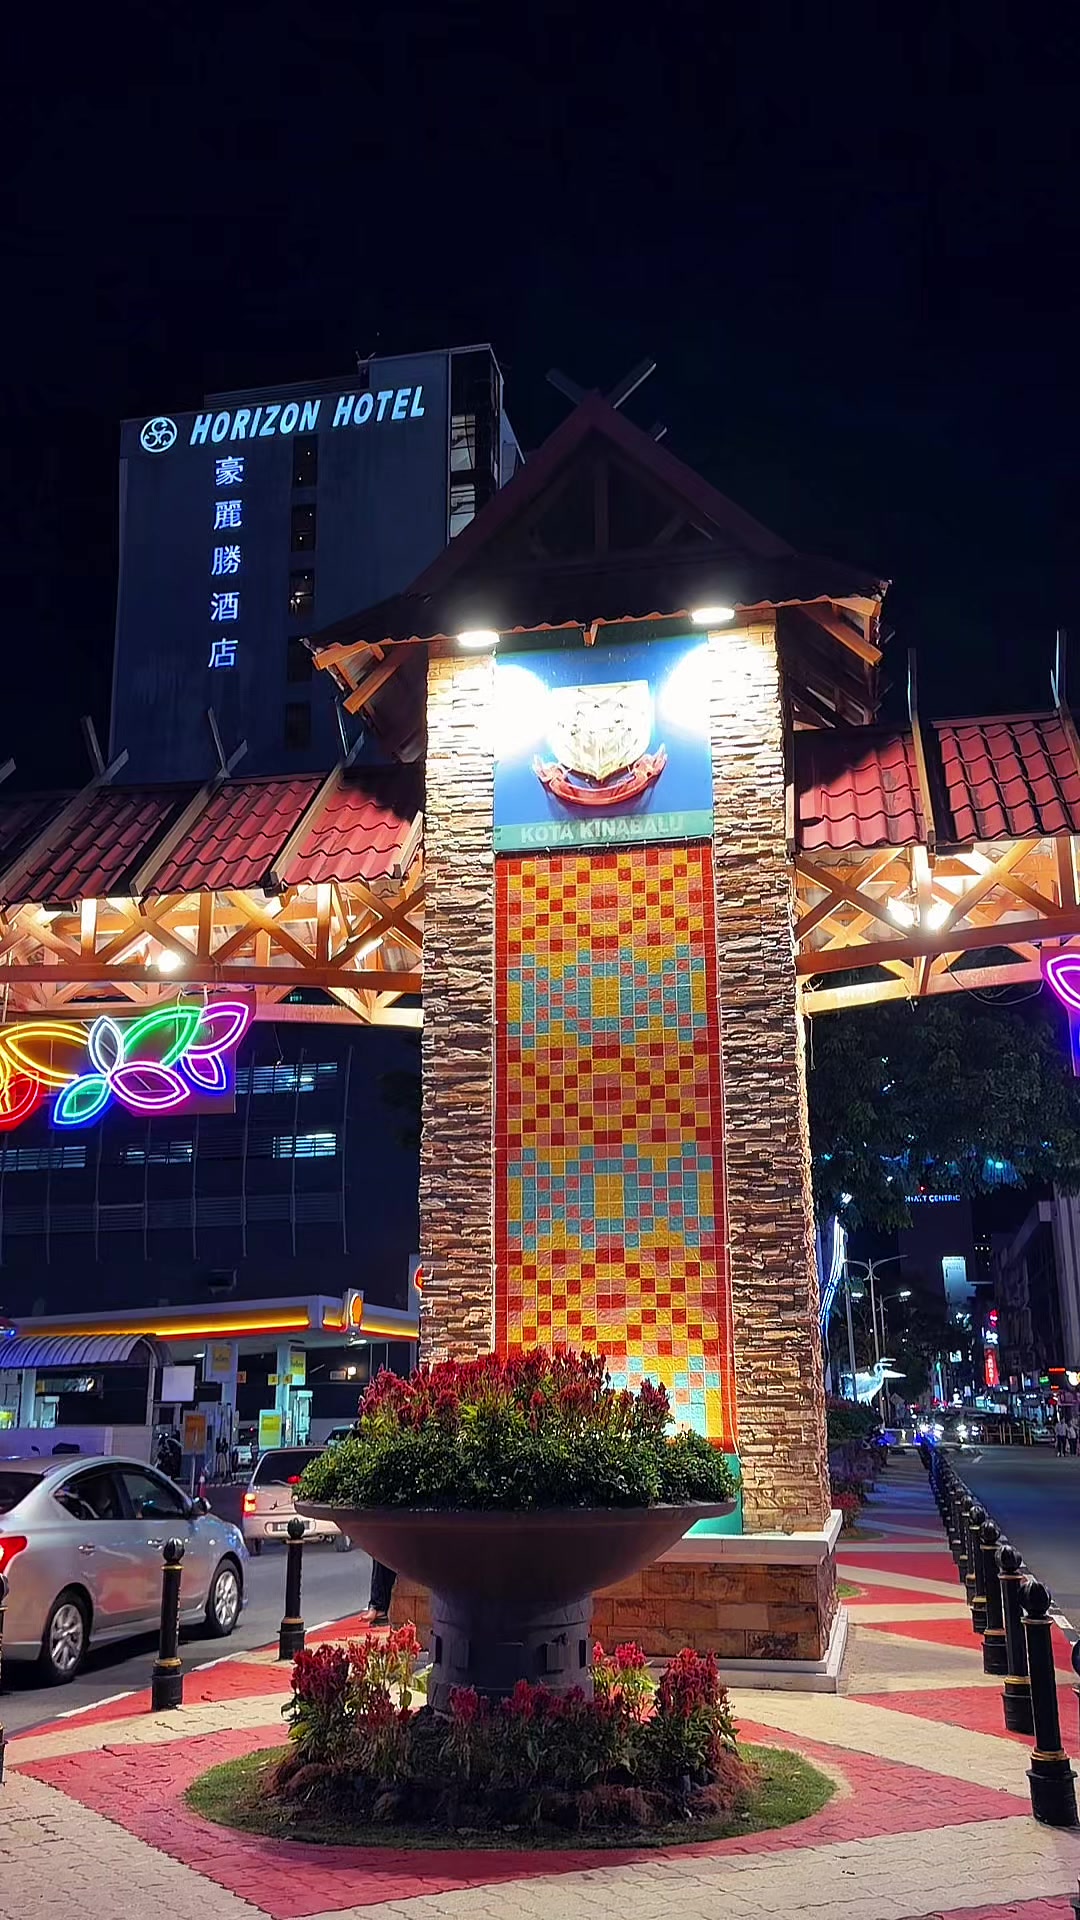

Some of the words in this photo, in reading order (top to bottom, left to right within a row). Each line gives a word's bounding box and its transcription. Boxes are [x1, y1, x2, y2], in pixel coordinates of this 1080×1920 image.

[190, 400, 321, 445] HORIZON
[332, 386, 425, 427] HOTEL
[208, 456, 244, 668] 豪麗勝酒店
[520, 825, 575, 843] KOTA
[580, 815, 684, 838] KINABALU
